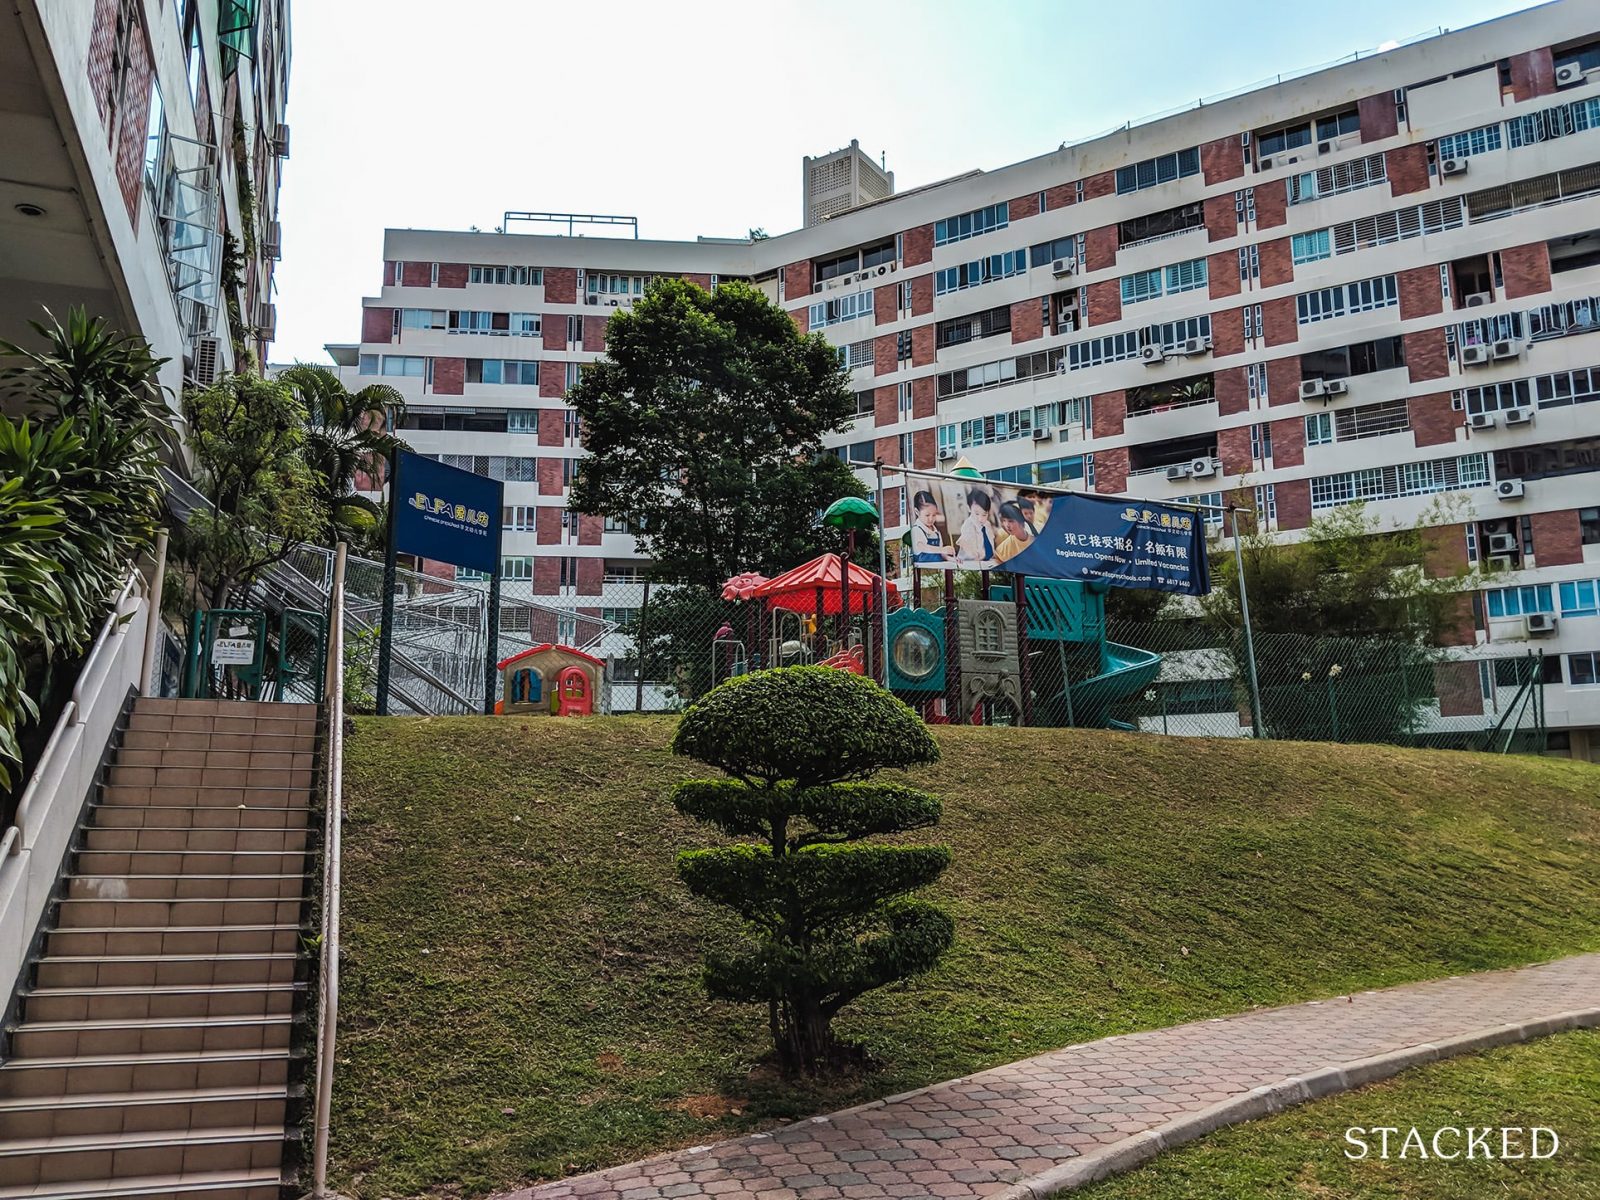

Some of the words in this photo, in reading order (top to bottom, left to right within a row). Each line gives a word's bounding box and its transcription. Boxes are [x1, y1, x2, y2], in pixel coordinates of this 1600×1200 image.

[1056, 548, 1094, 559] Registration
[1094, 553, 1114, 562] Opens
[1114, 555, 1126, 564] Now
[1134, 558, 1157, 567] Limited
[1157, 561, 1189, 572] Vacancies
[1144, 540, 1188, 560] 名额有限
